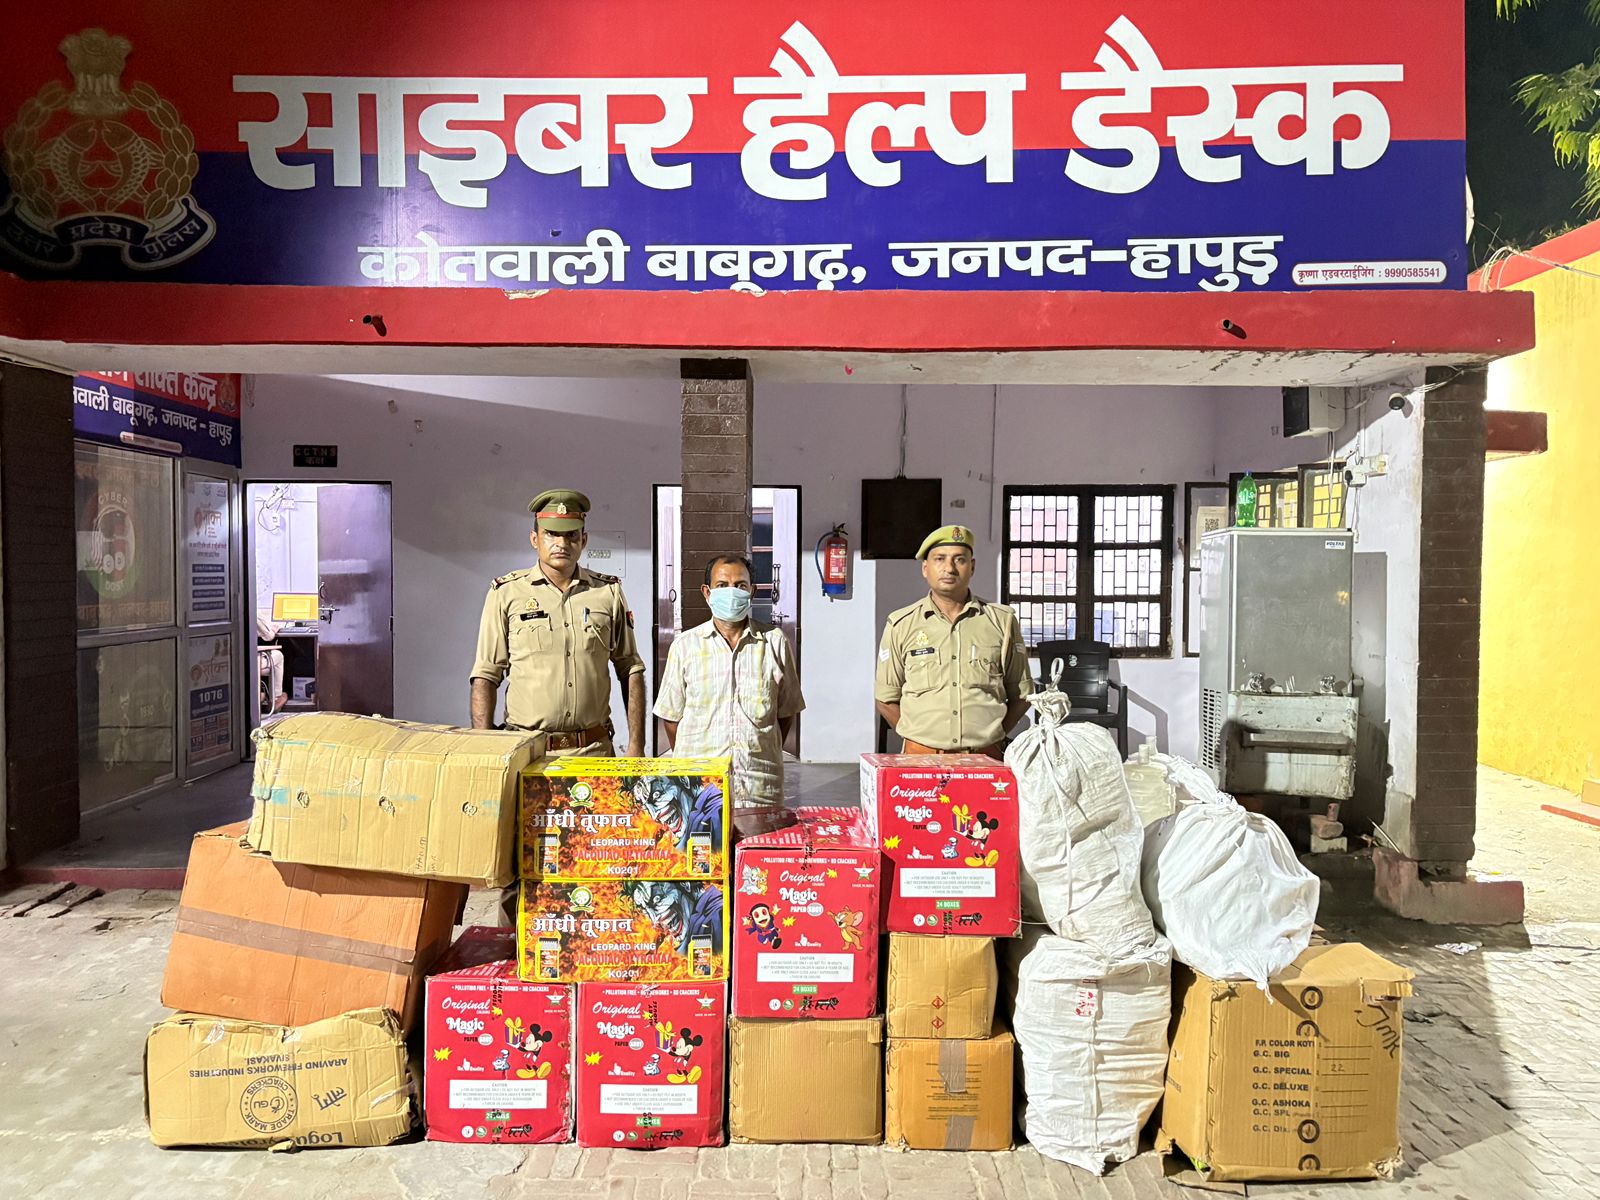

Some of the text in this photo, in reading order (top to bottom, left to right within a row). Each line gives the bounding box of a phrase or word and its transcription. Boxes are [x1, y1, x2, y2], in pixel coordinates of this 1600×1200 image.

[233, 15, 1403, 208] साइबर हैल्प डैस्क
[68, 217, 132, 240] प्रदेश
[144, 219, 201, 261] पुलिस
[358, 229, 630, 287] कोतवाली
[645, 243, 866, 293] बाबूगढ़,
[1298, 269, 1319, 283] कृष्णा
[1384, 267, 1440, 278] 9990585541
[161, 409, 197, 432] जनपद
[209, 421, 233, 447] हापुड़
[199, 689, 223, 703] 1076
[890, 785, 938, 802] Original
[531, 807, 634, 834] आँधी तूफान
[895, 805, 933, 822] Magic
[591, 838, 656, 847] LEOPARD KING
[780, 869, 826, 887] Original
[779, 887, 818, 905] Magic
[531, 912, 634, 938] आँधी तूफान
[591, 943, 657, 952] LEOPARD KING
[441, 996, 491, 1014] Original
[592, 1001, 642, 1018] Original
[446, 1017, 485, 1035] Magic
[596, 1021, 635, 1039] Magic
[189, 1057, 348, 1078] ARAVIND FIREWORKS INDUSTRIES
[1253, 1066, 1311, 1075] G.C. SPECIAL
[246, 1077, 289, 1096] CRACKERS
[1273, 1083, 1309, 1091] DELUXE
[311, 1086, 347, 1111] लोगू
[1252, 1098, 1311, 1107] G.C. ASHOKA
[243, 1108, 296, 1131] TRADE MARK
[296, 1130, 343, 1146] Logu
